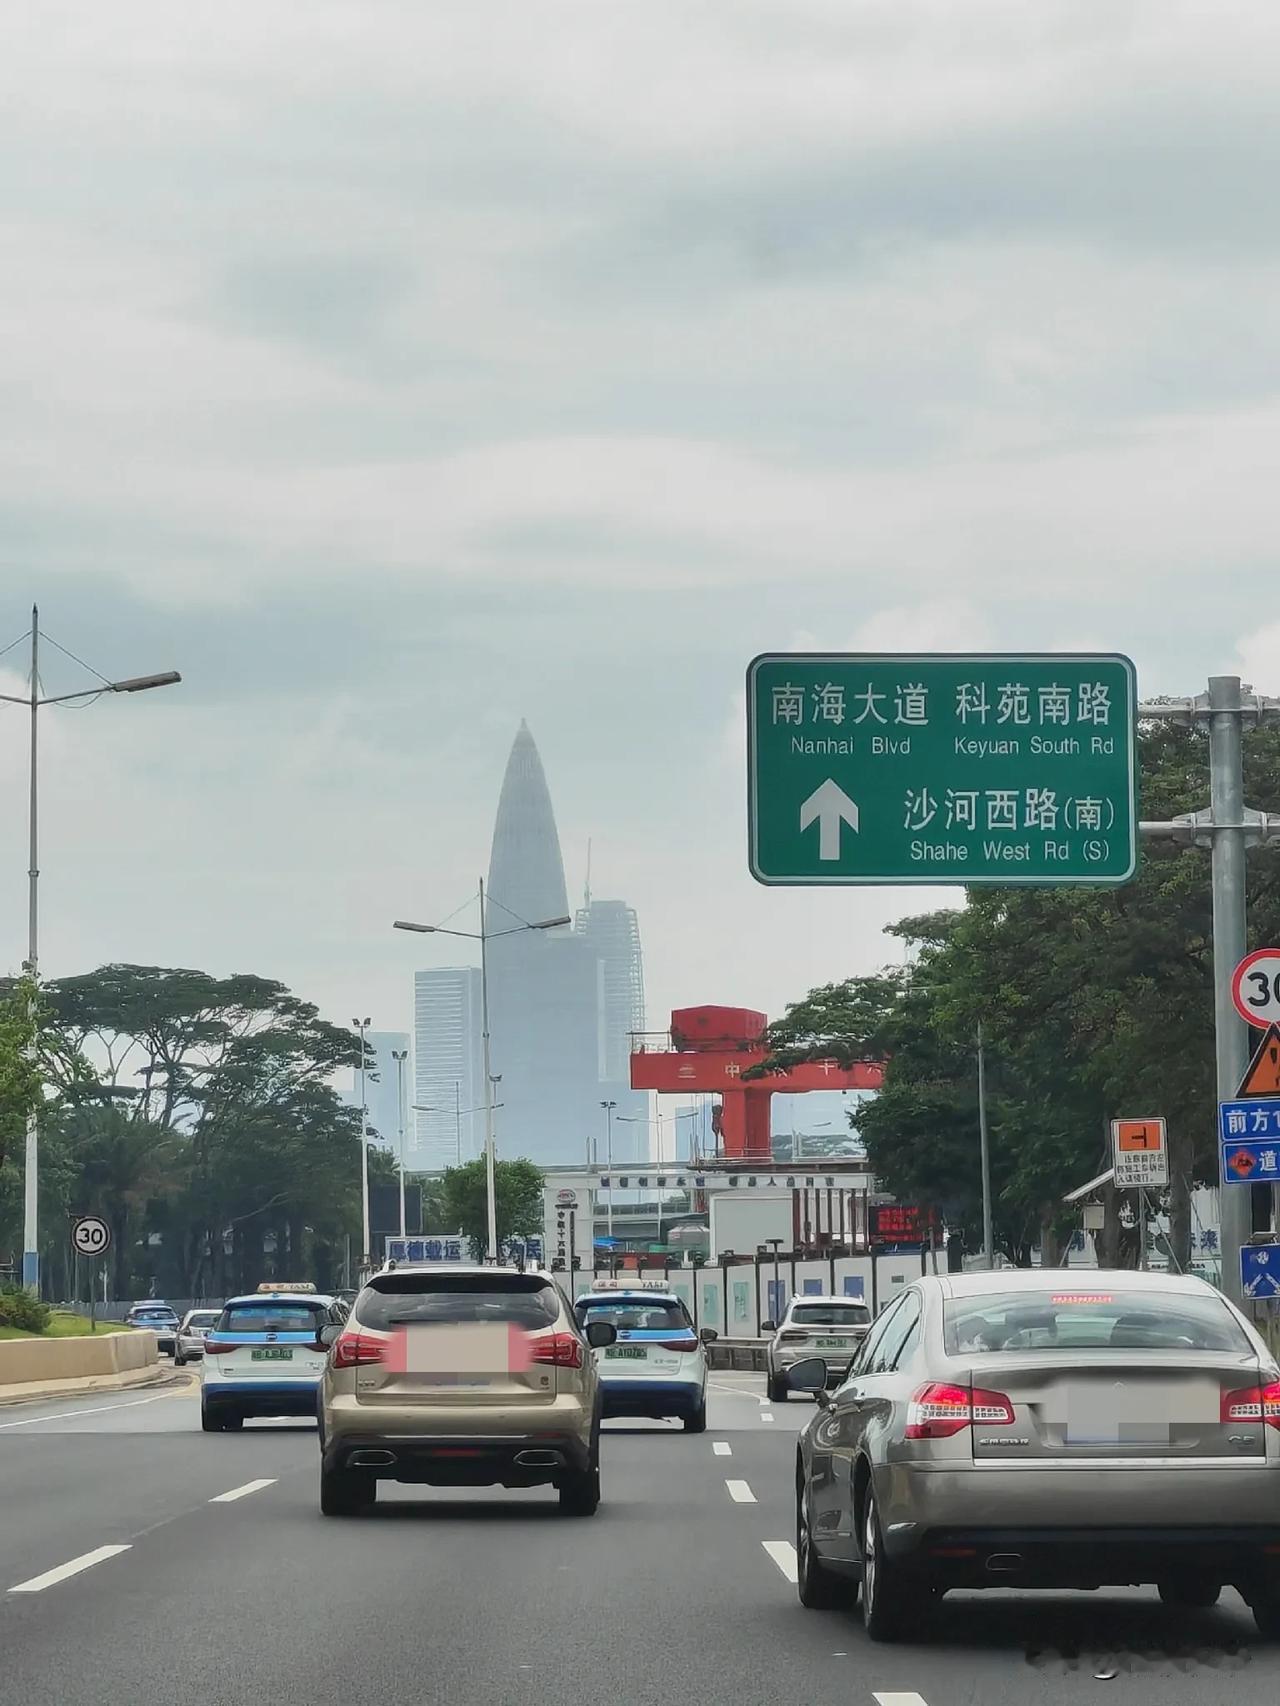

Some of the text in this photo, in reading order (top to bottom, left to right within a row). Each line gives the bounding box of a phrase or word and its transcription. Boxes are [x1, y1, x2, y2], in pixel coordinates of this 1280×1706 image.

[773, 682, 929, 725] 南海大道
[956, 682, 1112, 726] 科苑南路
[791, 736, 911, 755] Nanhai Blvd
[955, 736, 1114, 758] Keyuan South Rd
[903, 787, 1114, 831] 沙河西路(南)
[910, 840, 1110, 861] Shahe West Rd (S)
[1247, 971, 1280, 1007] 3
[77, 1227, 103, 1246] 30
